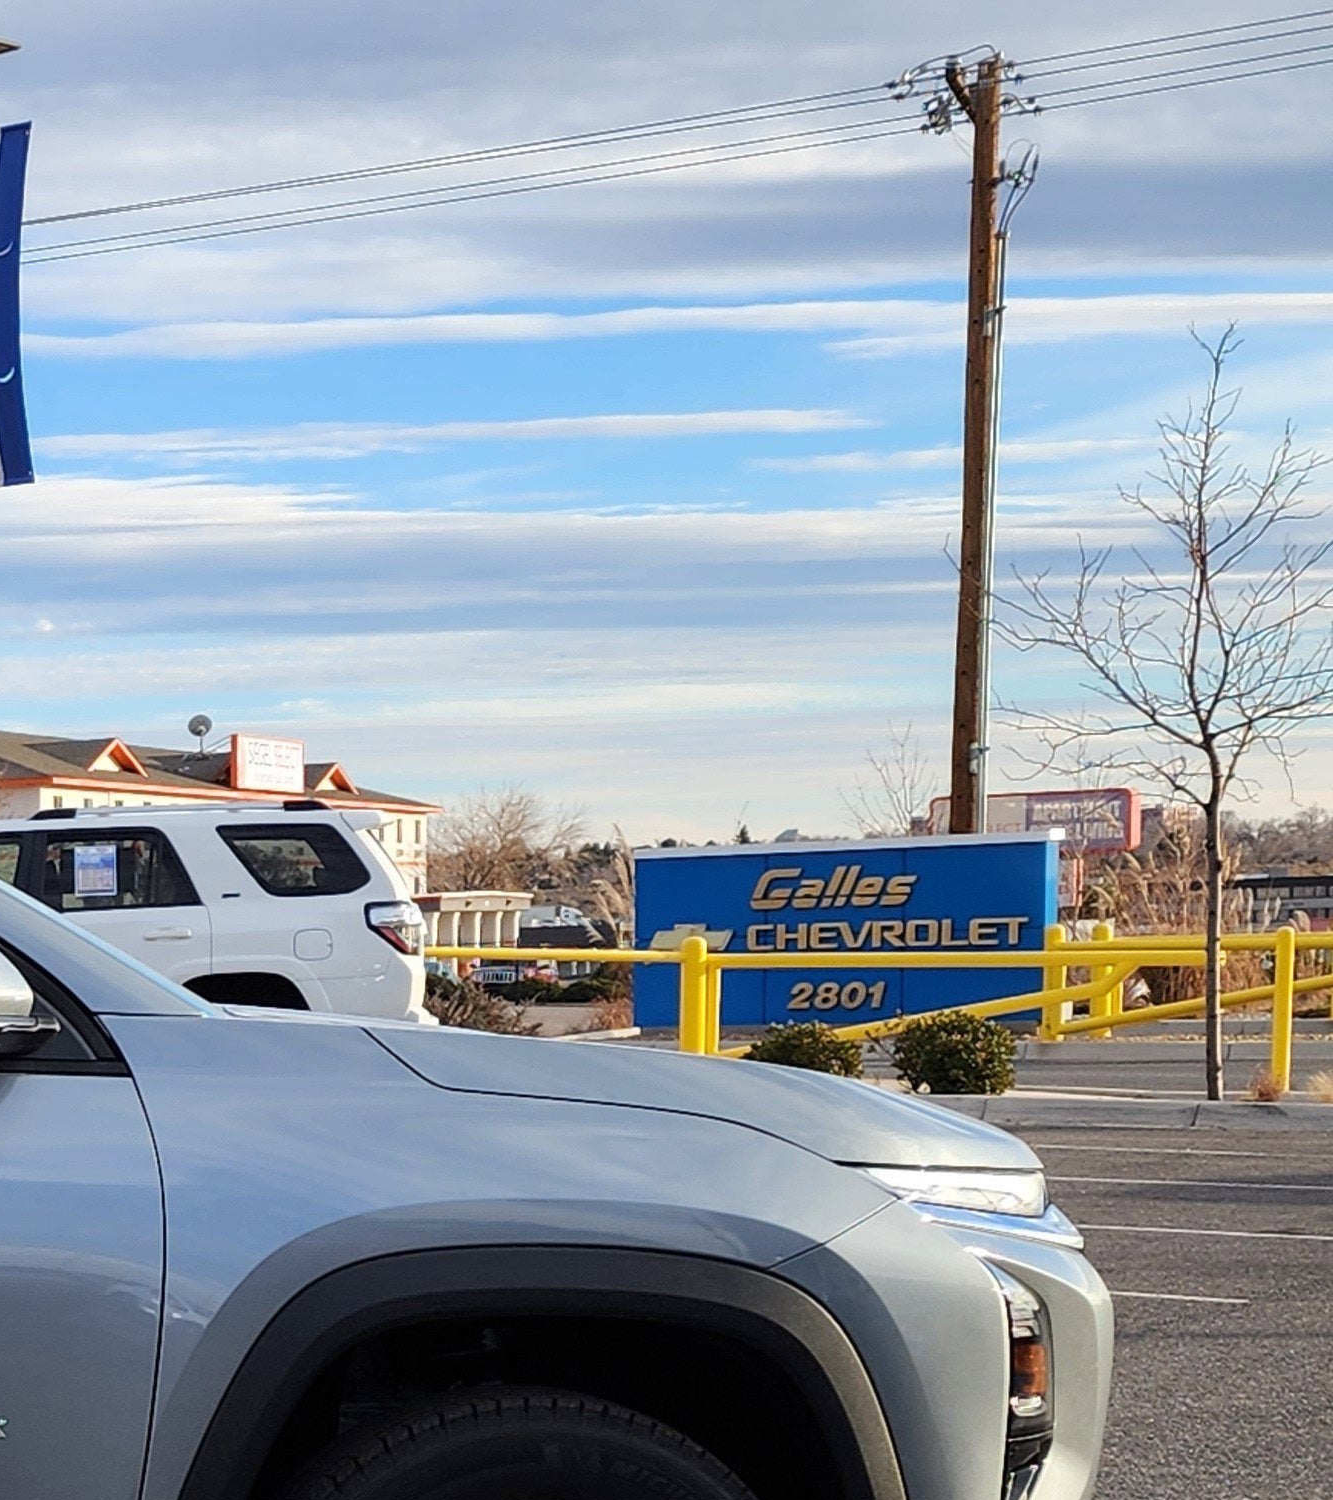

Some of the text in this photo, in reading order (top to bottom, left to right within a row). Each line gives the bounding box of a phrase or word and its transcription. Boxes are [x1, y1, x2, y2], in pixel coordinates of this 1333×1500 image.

[749, 865, 917, 910] Galles
[746, 916, 1032, 951] CHEVROLET
[787, 981, 887, 1011] 2801
